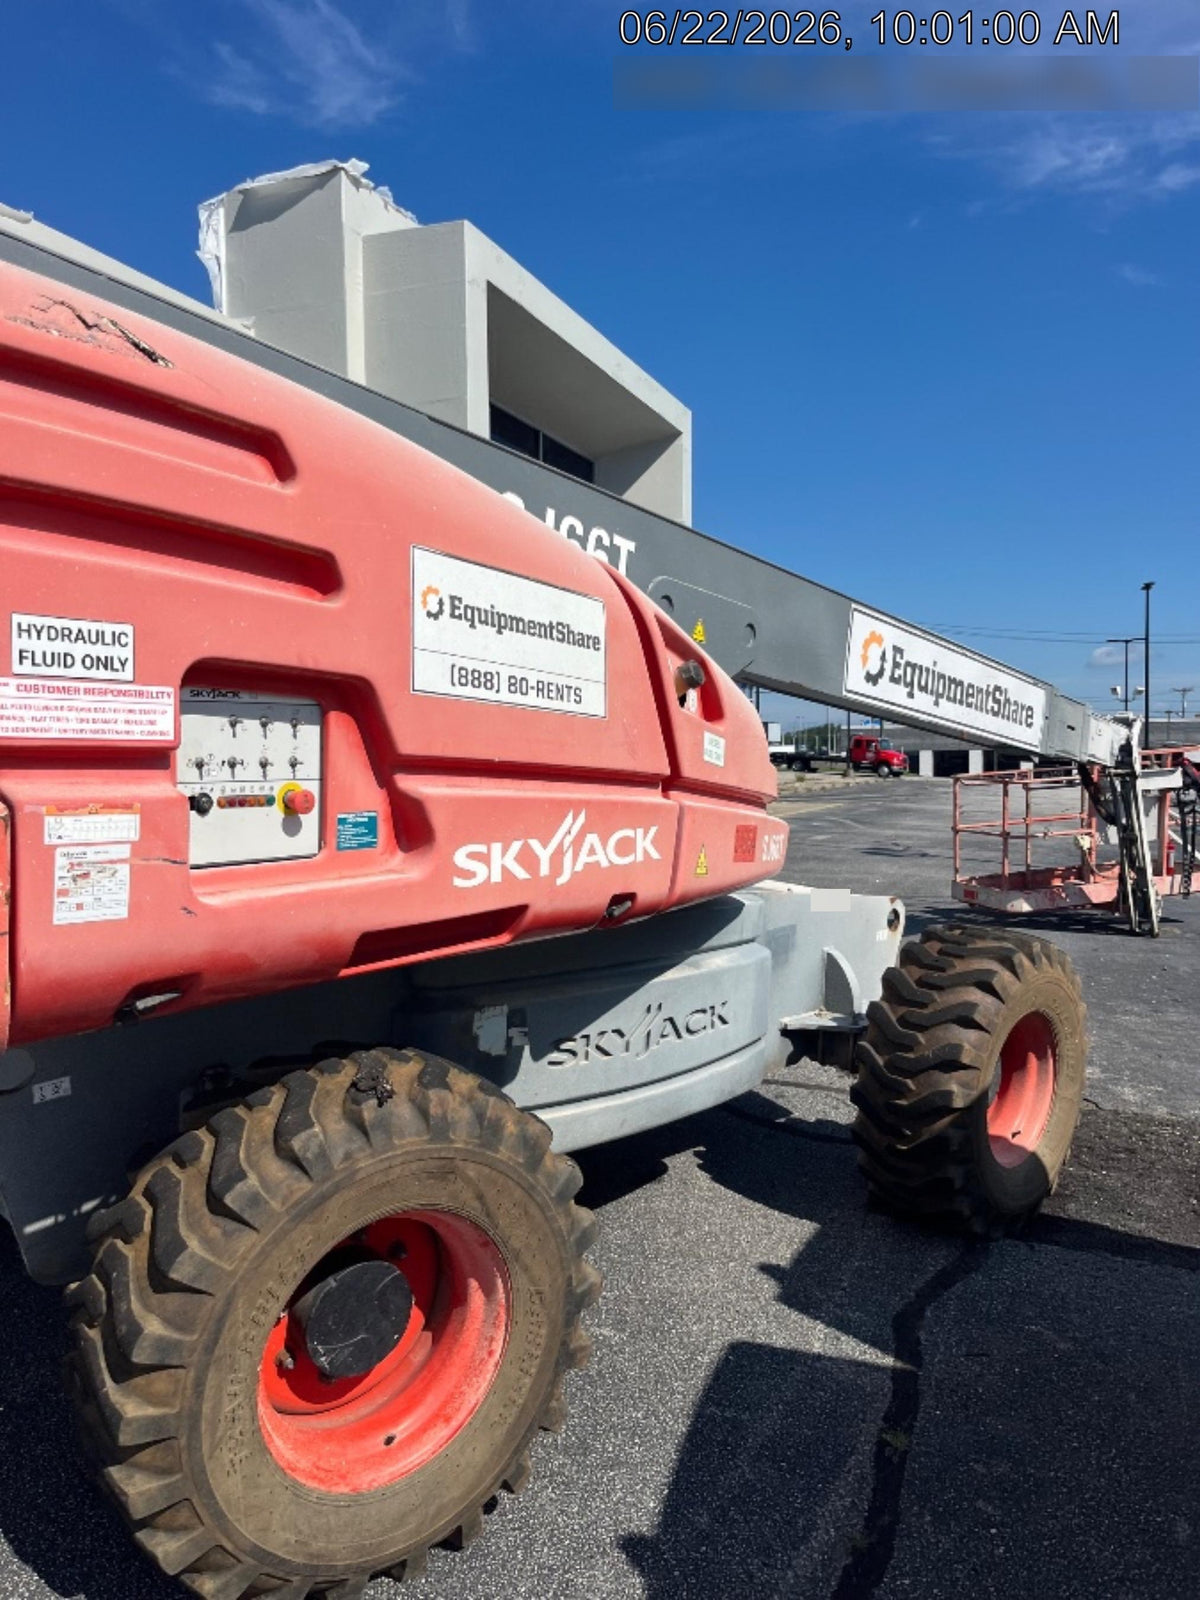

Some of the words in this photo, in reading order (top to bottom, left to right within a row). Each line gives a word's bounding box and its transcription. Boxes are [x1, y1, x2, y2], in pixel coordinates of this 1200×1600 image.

[17, 622, 129, 648] HYDRAULIC
[449, 594, 601, 651] EquipmentShare
[18, 648, 75, 669] FLUID
[81, 654, 129, 672] ONLY
[450, 663, 500, 694] (888)
[508, 675, 583, 705] 80-RENTS
[16, 683, 81, 696] CUSTOMER
[83, 687, 173, 700] RESPONSIBILITY
[889, 644, 1034, 729] EquipmentShare
[453, 809, 662, 888] SKYJACK
[547, 1002, 729, 1069] SKYJACK
